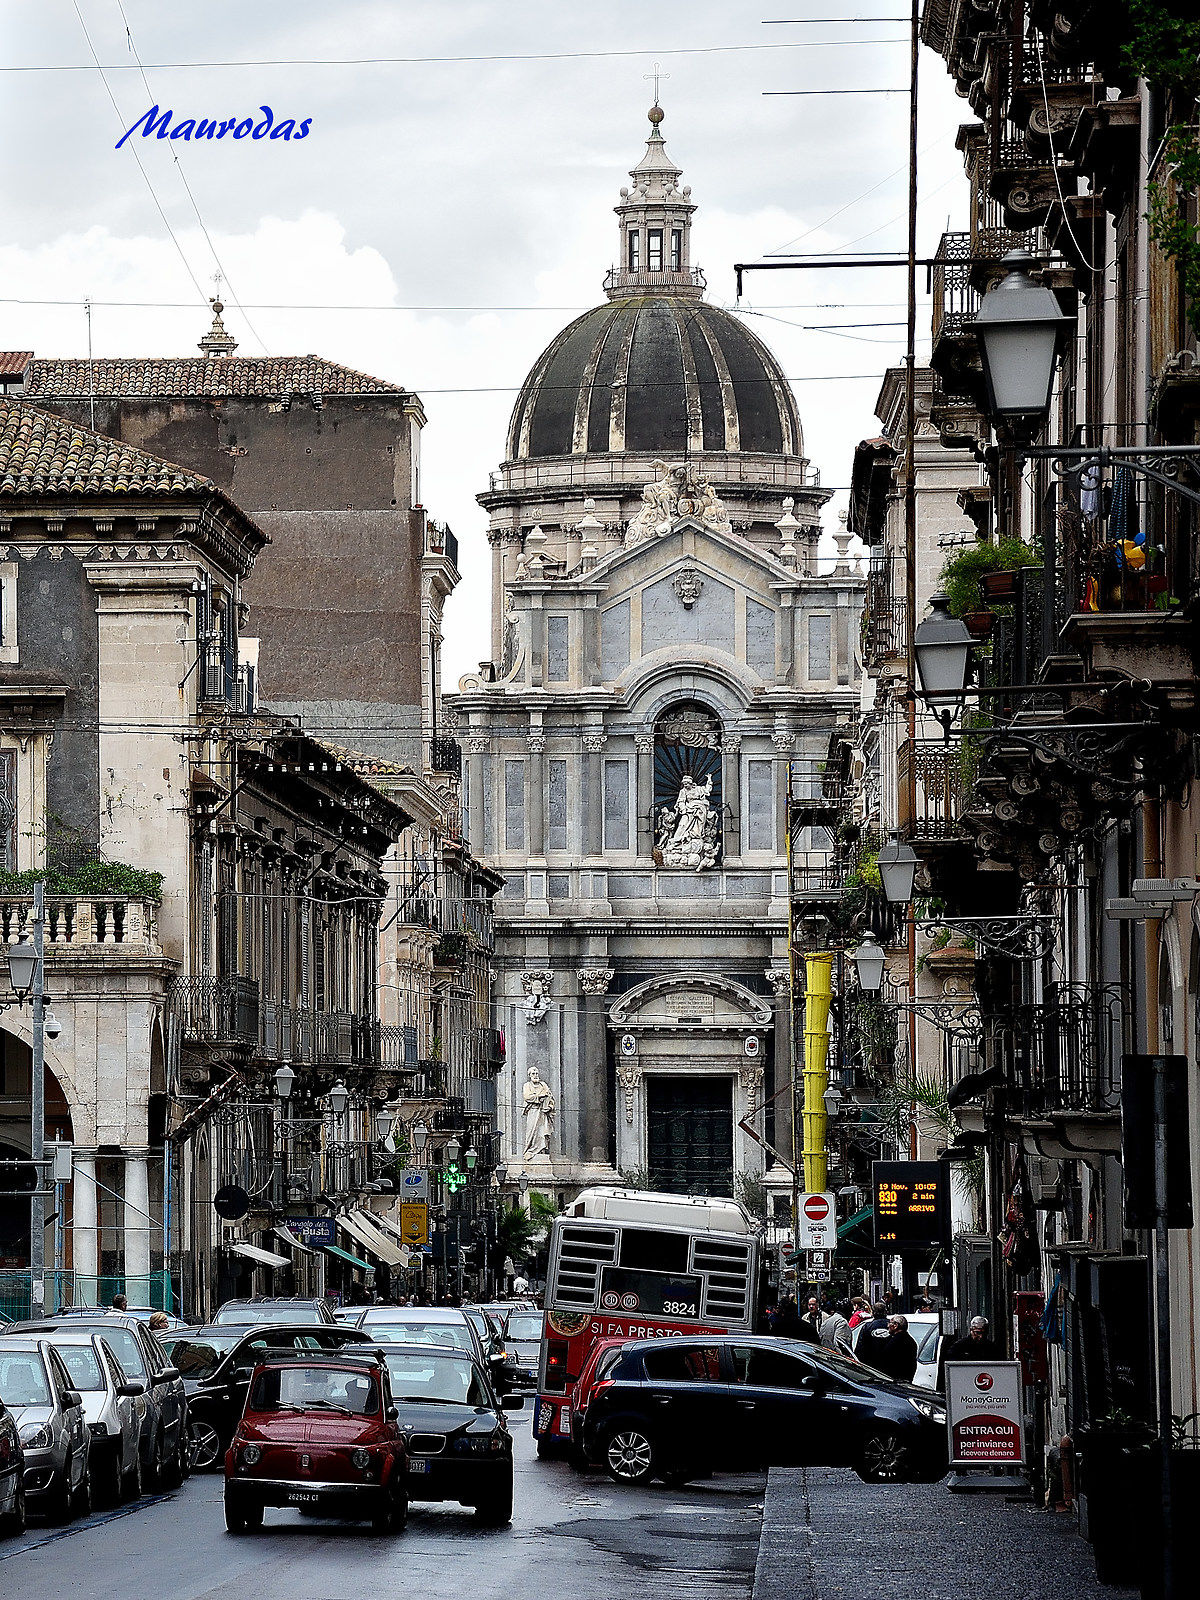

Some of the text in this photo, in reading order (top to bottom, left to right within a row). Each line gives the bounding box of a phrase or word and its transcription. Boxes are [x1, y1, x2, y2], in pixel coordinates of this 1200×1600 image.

[878, 1190, 898, 1202] 830
[302, 1227, 330, 1236] Busta
[606, 1296, 635, 1306] 80 100
[662, 1300, 697, 1316] 3824
[591, 1322, 683, 1338] SI FA PRESTO
[960, 1396, 1010, 1404] MoneyGram
[959, 1426, 1014, 1435] ENTRA QUI
[960, 1441, 976, 1449] per
[976, 1440, 1007, 1448] inviare
